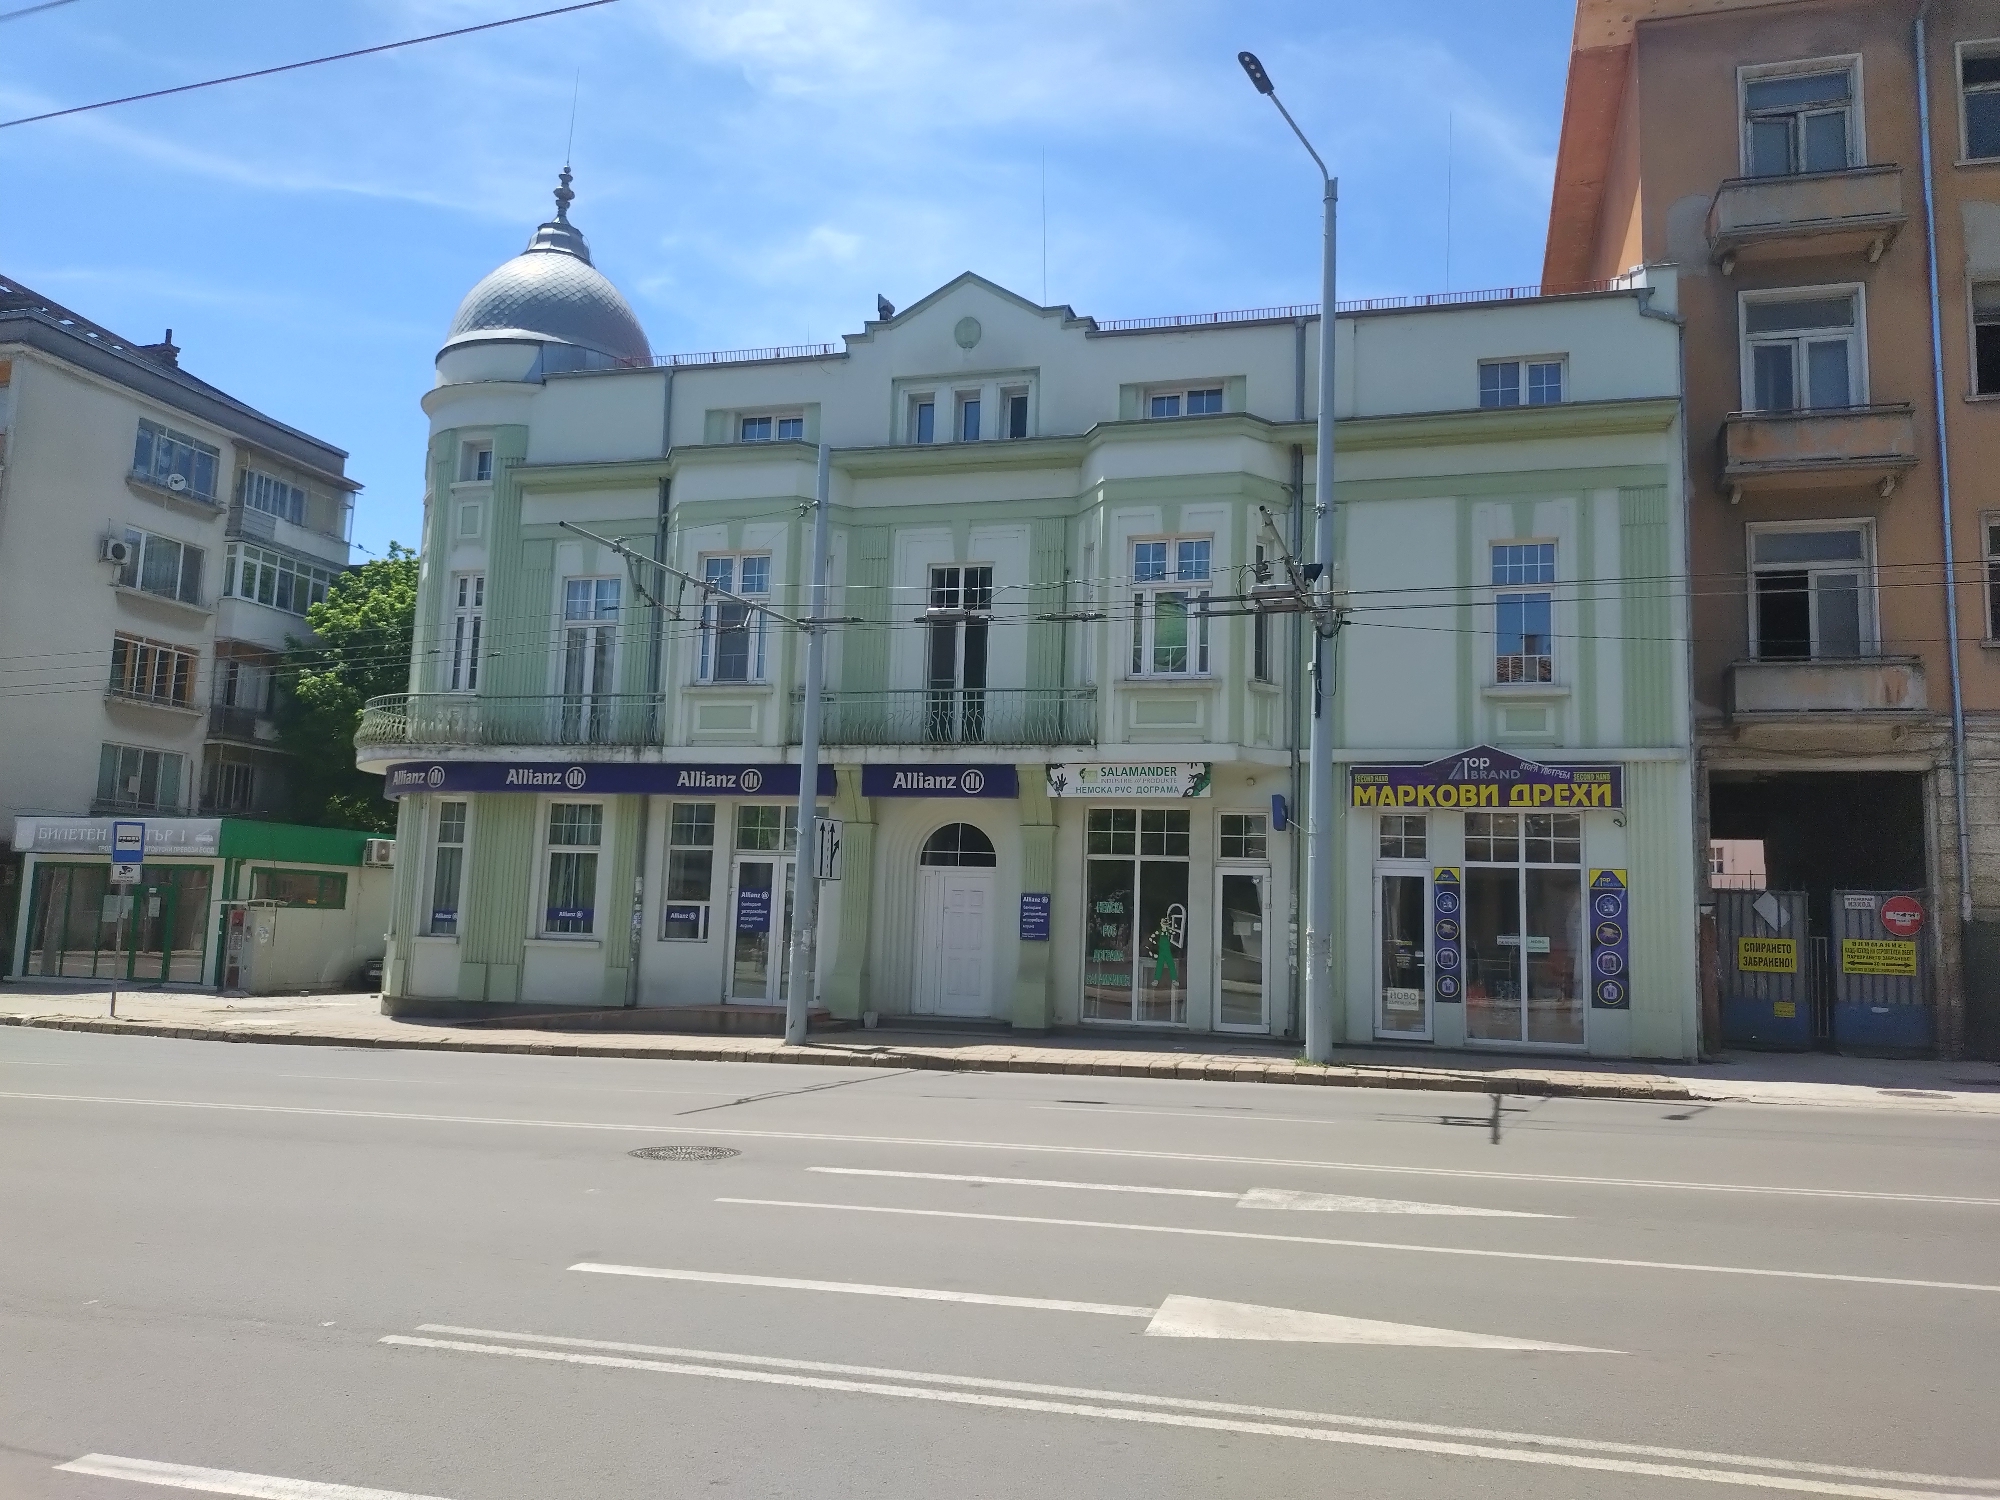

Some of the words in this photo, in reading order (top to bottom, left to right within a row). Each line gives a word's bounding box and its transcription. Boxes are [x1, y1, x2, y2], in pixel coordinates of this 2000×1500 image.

[1100, 766, 1177, 777] SALAMANDER
[1520, 762, 1539, 773] ВТОРА
[393, 770, 426, 785] Allianz
[506, 769, 562, 785] Allianz
[677, 770, 736, 788] Allianz
[893, 772, 957, 789] Allianz
[1354, 774, 1374, 783] SECOND
[1375, 774, 1389, 783] HAND
[1471, 769, 1521, 780] BRAND
[1573, 773, 1594, 781] SECOND
[1595, 773, 1611, 781] HAND
[1075, 785, 1113, 794] НЕМСКА
[1115, 785, 1132, 794] PVC
[1135, 785, 1180, 795] ДОГРАМА
[1353, 784, 1499, 807] МАРКОВИ
[1508, 783, 1612, 807] ДРЕХИ
[38, 827, 107, 841] БИЛЕТЕН
[1744, 942, 1792, 954] СПИРАНЕТО
[1742, 956, 1793, 968] ЗАБРАНЕНО!
[1390, 991, 1417, 1001] НОВО
